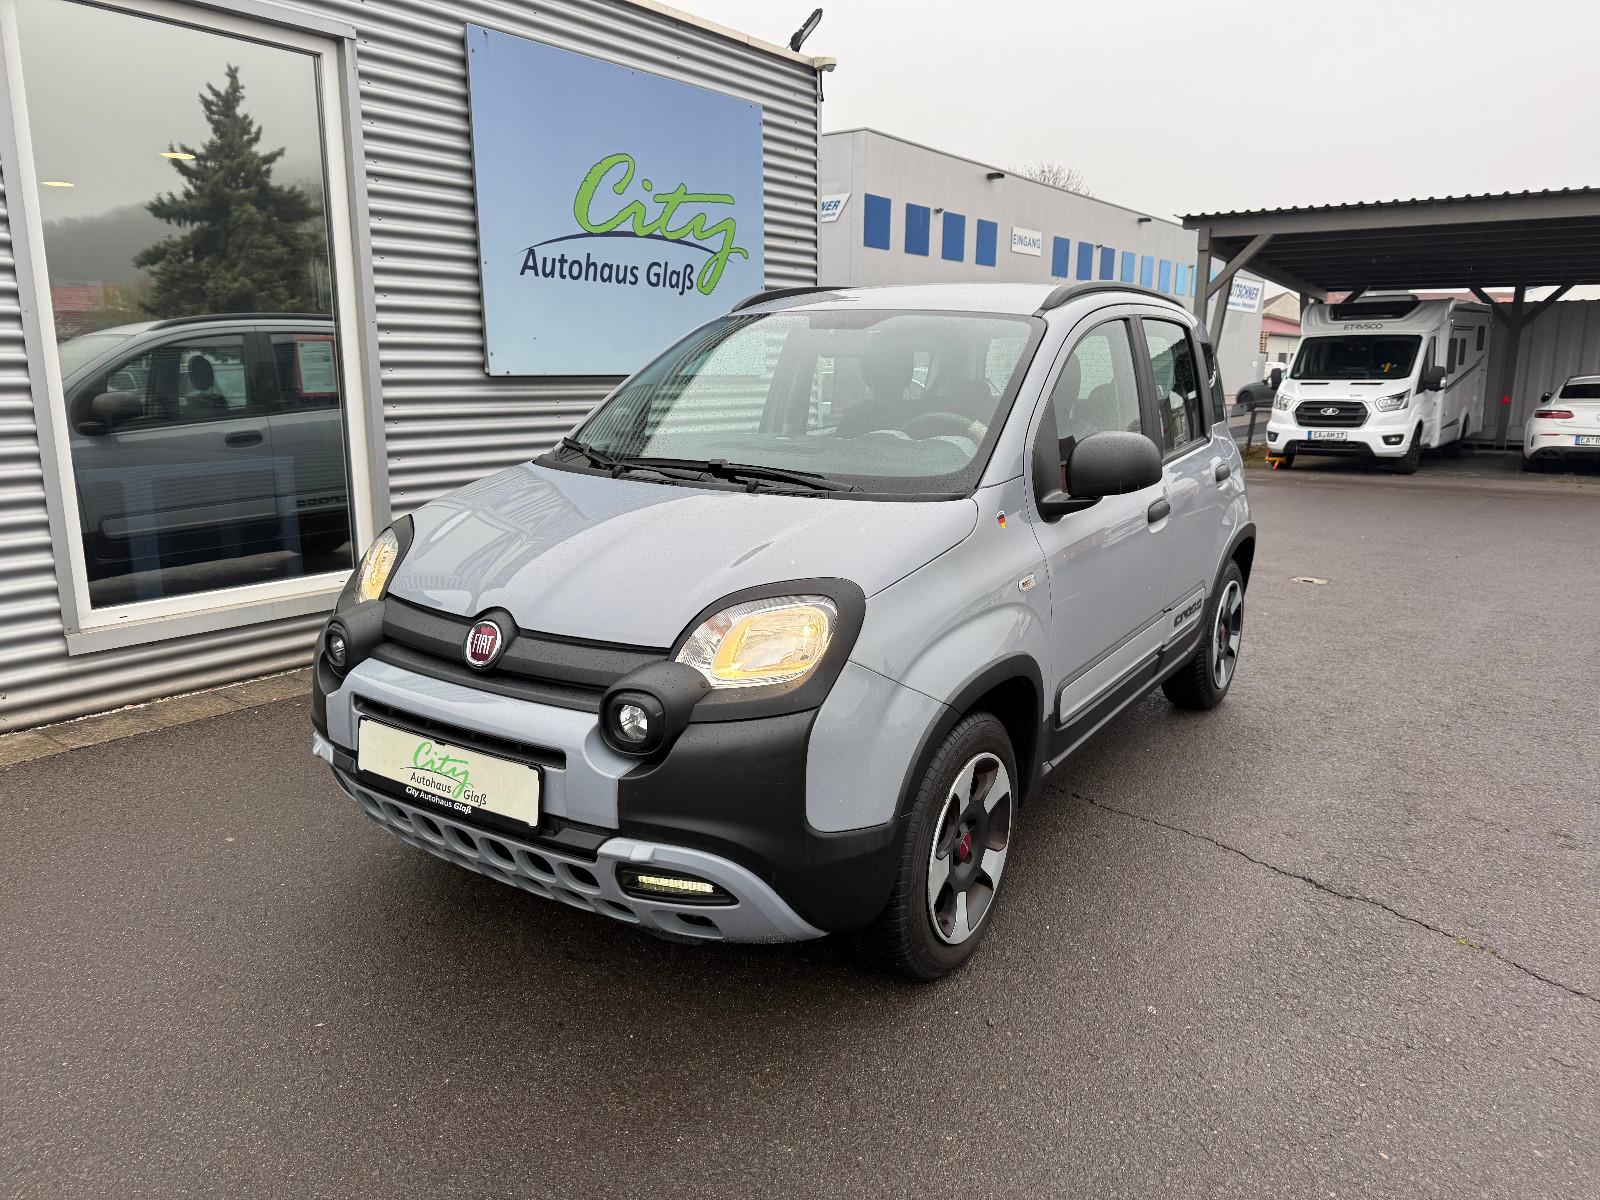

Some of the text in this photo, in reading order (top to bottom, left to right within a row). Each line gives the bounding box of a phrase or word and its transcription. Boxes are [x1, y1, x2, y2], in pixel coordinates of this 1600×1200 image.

[573, 153, 748, 295] City
[1013, 233, 1041, 249] EINGANG
[520, 248, 695, 296] Autohaus Glaß
[472, 633, 495, 655] FIAT
[413, 741, 474, 800] City
[405, 785, 473, 815] City Autohaus Glaß
[410, 771, 488, 807] Autohaus Glaß
